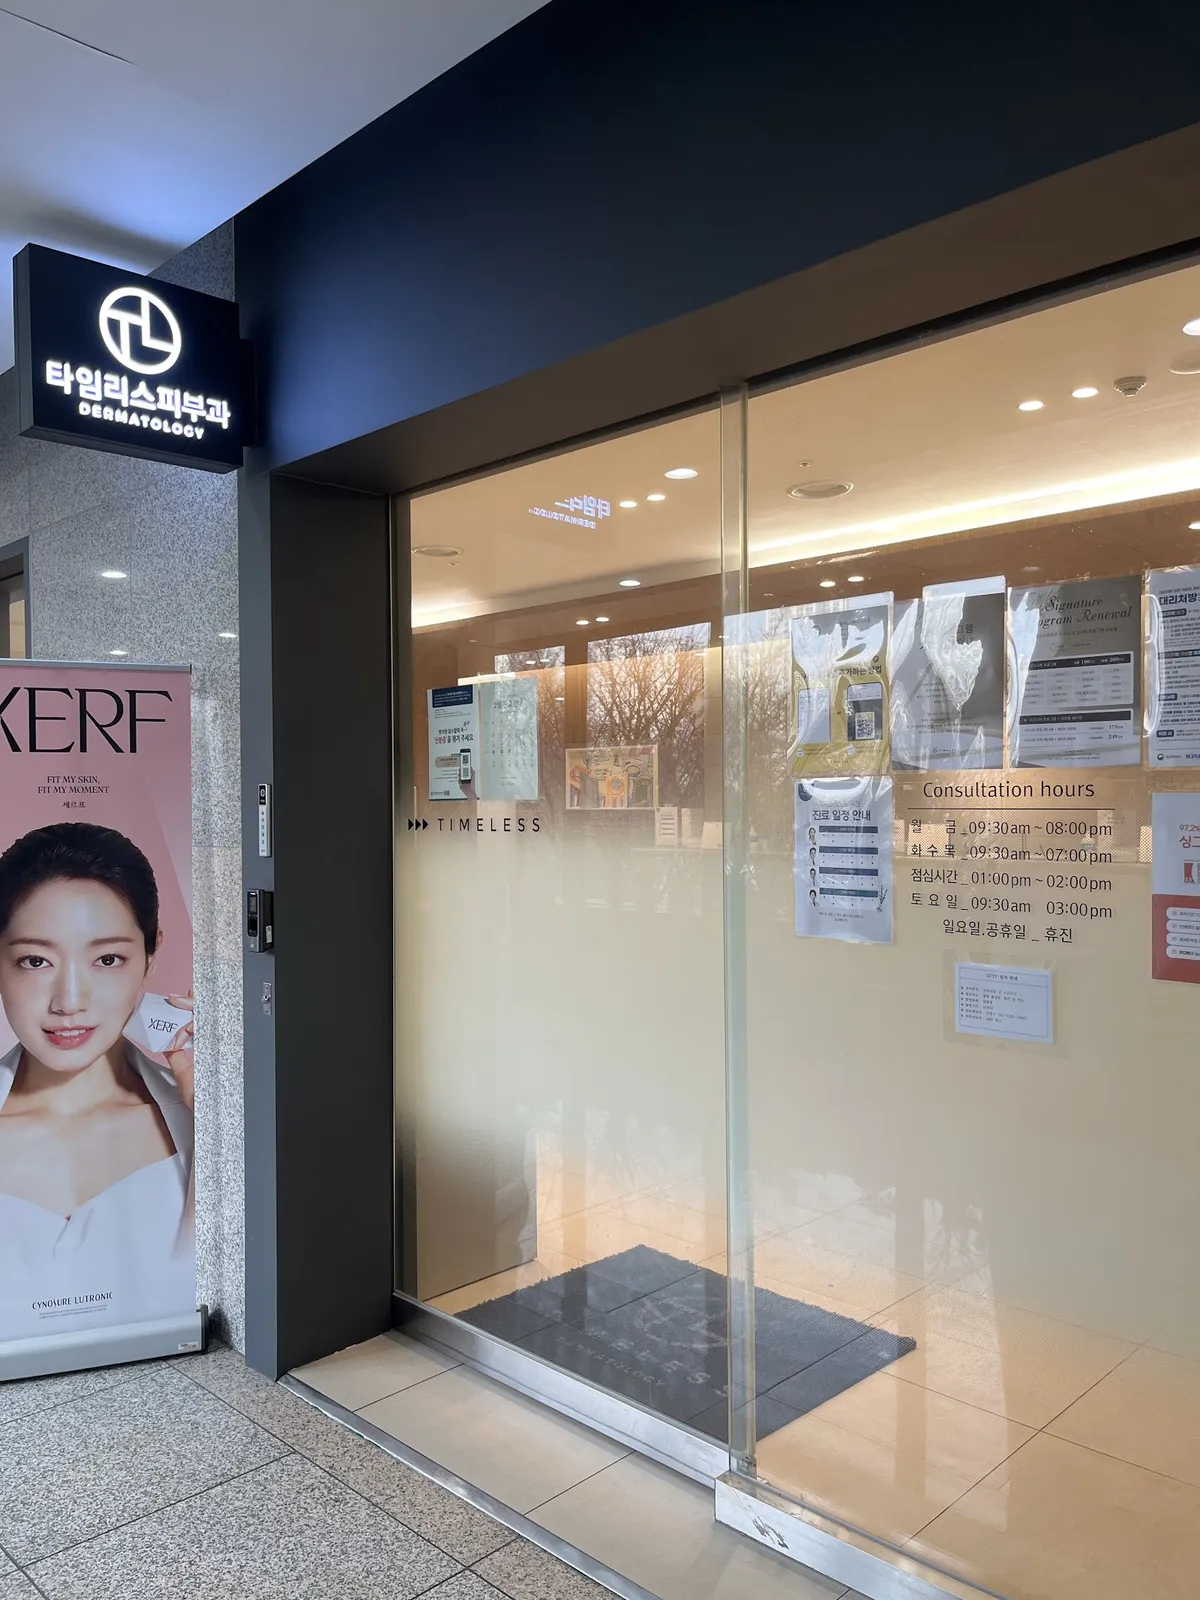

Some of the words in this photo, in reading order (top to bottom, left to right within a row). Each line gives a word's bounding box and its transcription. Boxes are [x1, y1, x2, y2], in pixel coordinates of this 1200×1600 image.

[45, 359, 231, 430] 타임리스피부과
[78, 402, 205, 440] DERMATOLOGY
[1045, 595, 1103, 613] Signature
[1077, 606, 1132, 623] Renewal
[47, 775, 61, 784] FIT
[62, 775, 77, 784] MY
[77, 775, 100, 785] SKIN,
[37, 786, 52, 794] FIT
[53, 786, 68, 794] MY
[68, 785, 110, 794] MOMENT
[923, 782, 1033, 798] Consultation
[1041, 781, 1095, 798] hours
[62, 801, 86, 809] 세르프
[812, 809, 830, 821] 진료
[832, 809, 850, 821] 일정
[852, 809, 871, 821] 안내
[437, 818, 541, 832] TIMELESS
[911, 819, 922, 834] 월
[945, 819, 956, 834] 금
[1045, 821, 1112, 836] 08:00pm
[1045, 848, 1112, 864] 07:00pm
[910, 868, 958, 884] 점심시간
[1046, 875, 1112, 892] 02:00pm
[1046, 901, 1112, 919] 03:00pm
[1044, 926, 1073, 944] 휴진
[148, 1018, 178, 1033] XERF
[32, 1297, 73, 1310] CYNOSURE
[74, 1291, 114, 1304] LUTRONIC
